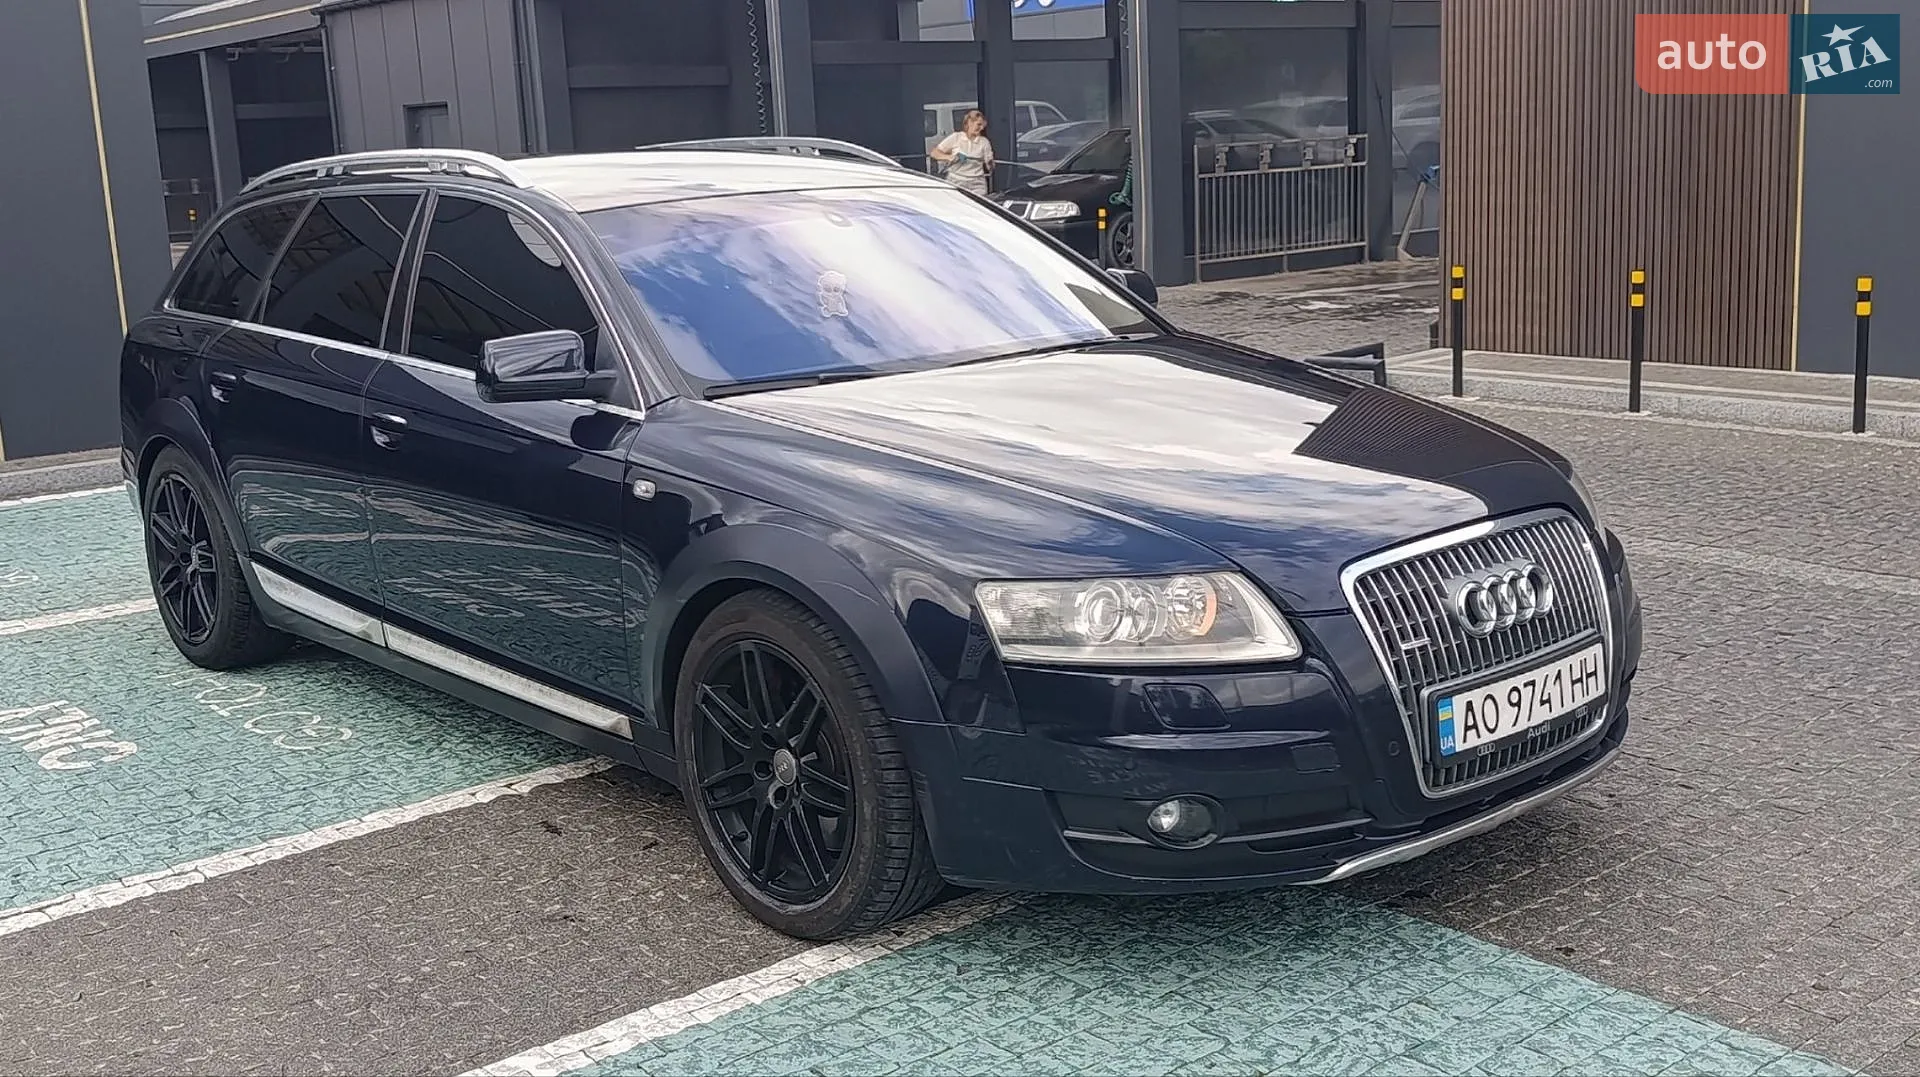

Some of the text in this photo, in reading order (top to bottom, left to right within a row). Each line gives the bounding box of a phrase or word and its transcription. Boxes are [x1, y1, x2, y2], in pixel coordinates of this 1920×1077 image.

[1462, 652, 1599, 744] AO 9741 HH
[1527, 721, 1551, 739] Audi
[1440, 736, 1455, 750] UA
